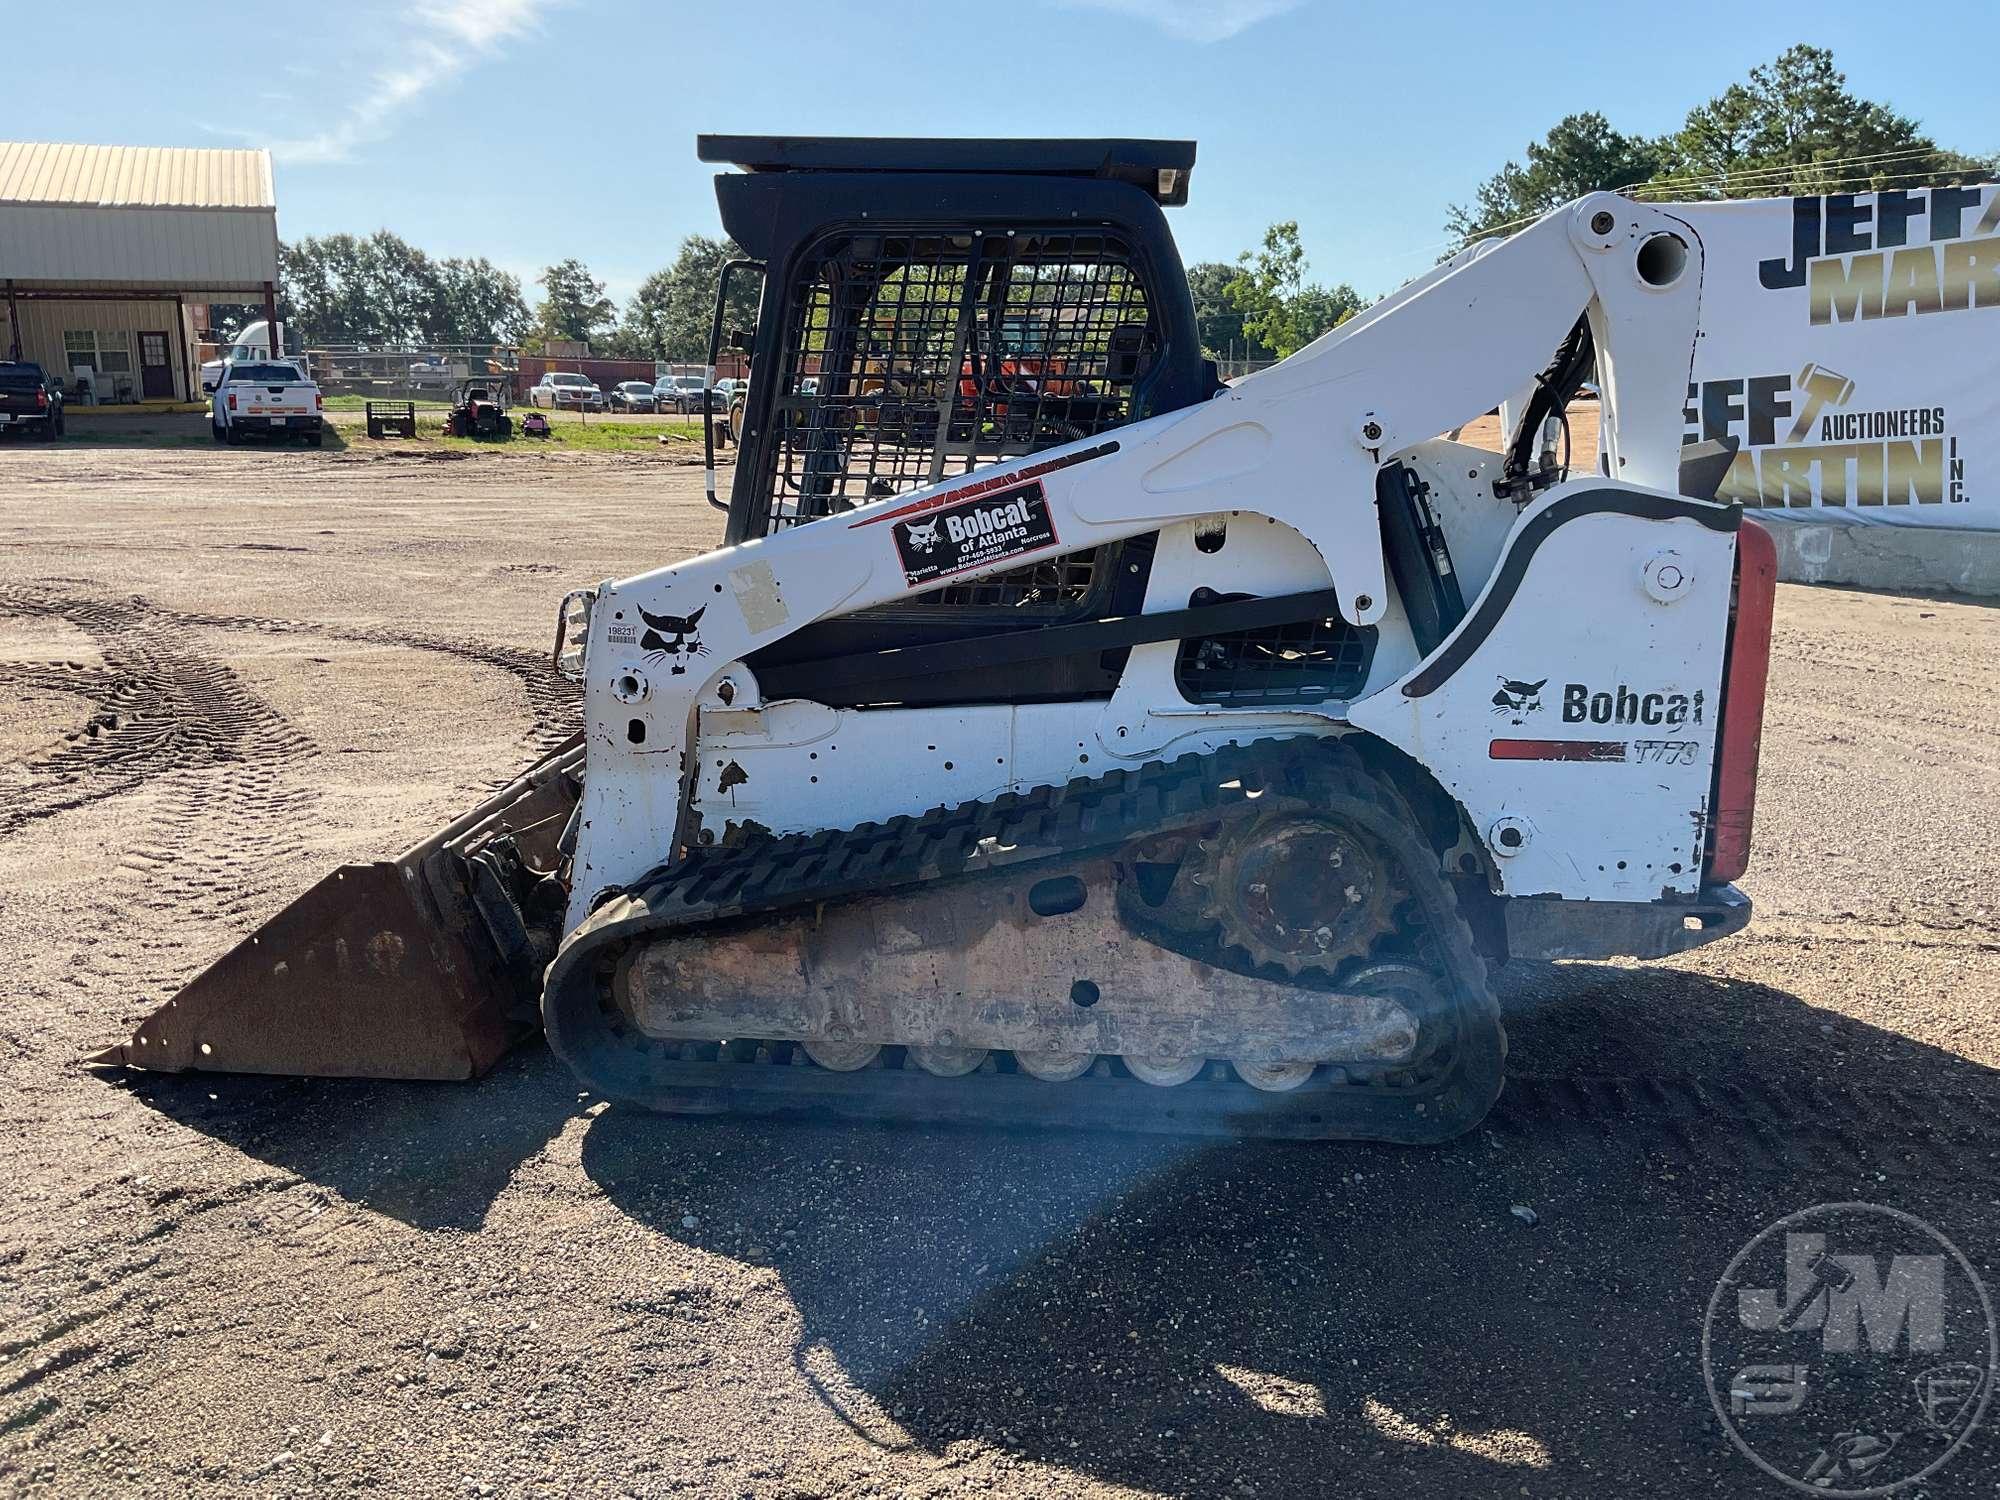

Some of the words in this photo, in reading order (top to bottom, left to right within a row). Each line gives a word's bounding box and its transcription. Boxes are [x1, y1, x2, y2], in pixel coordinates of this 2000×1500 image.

[1759, 188, 1981, 289] JEFF
[1821, 407, 1945, 441] AUCTIONEERS
[1714, 438, 1943, 508] ARTIN
[945, 496, 1031, 543] Bobcat
[960, 539, 975, 553] of
[978, 525, 1028, 549] Atlanta
[1020, 532, 1051, 545] Norcross
[1562, 683, 1705, 726] Bobcat
